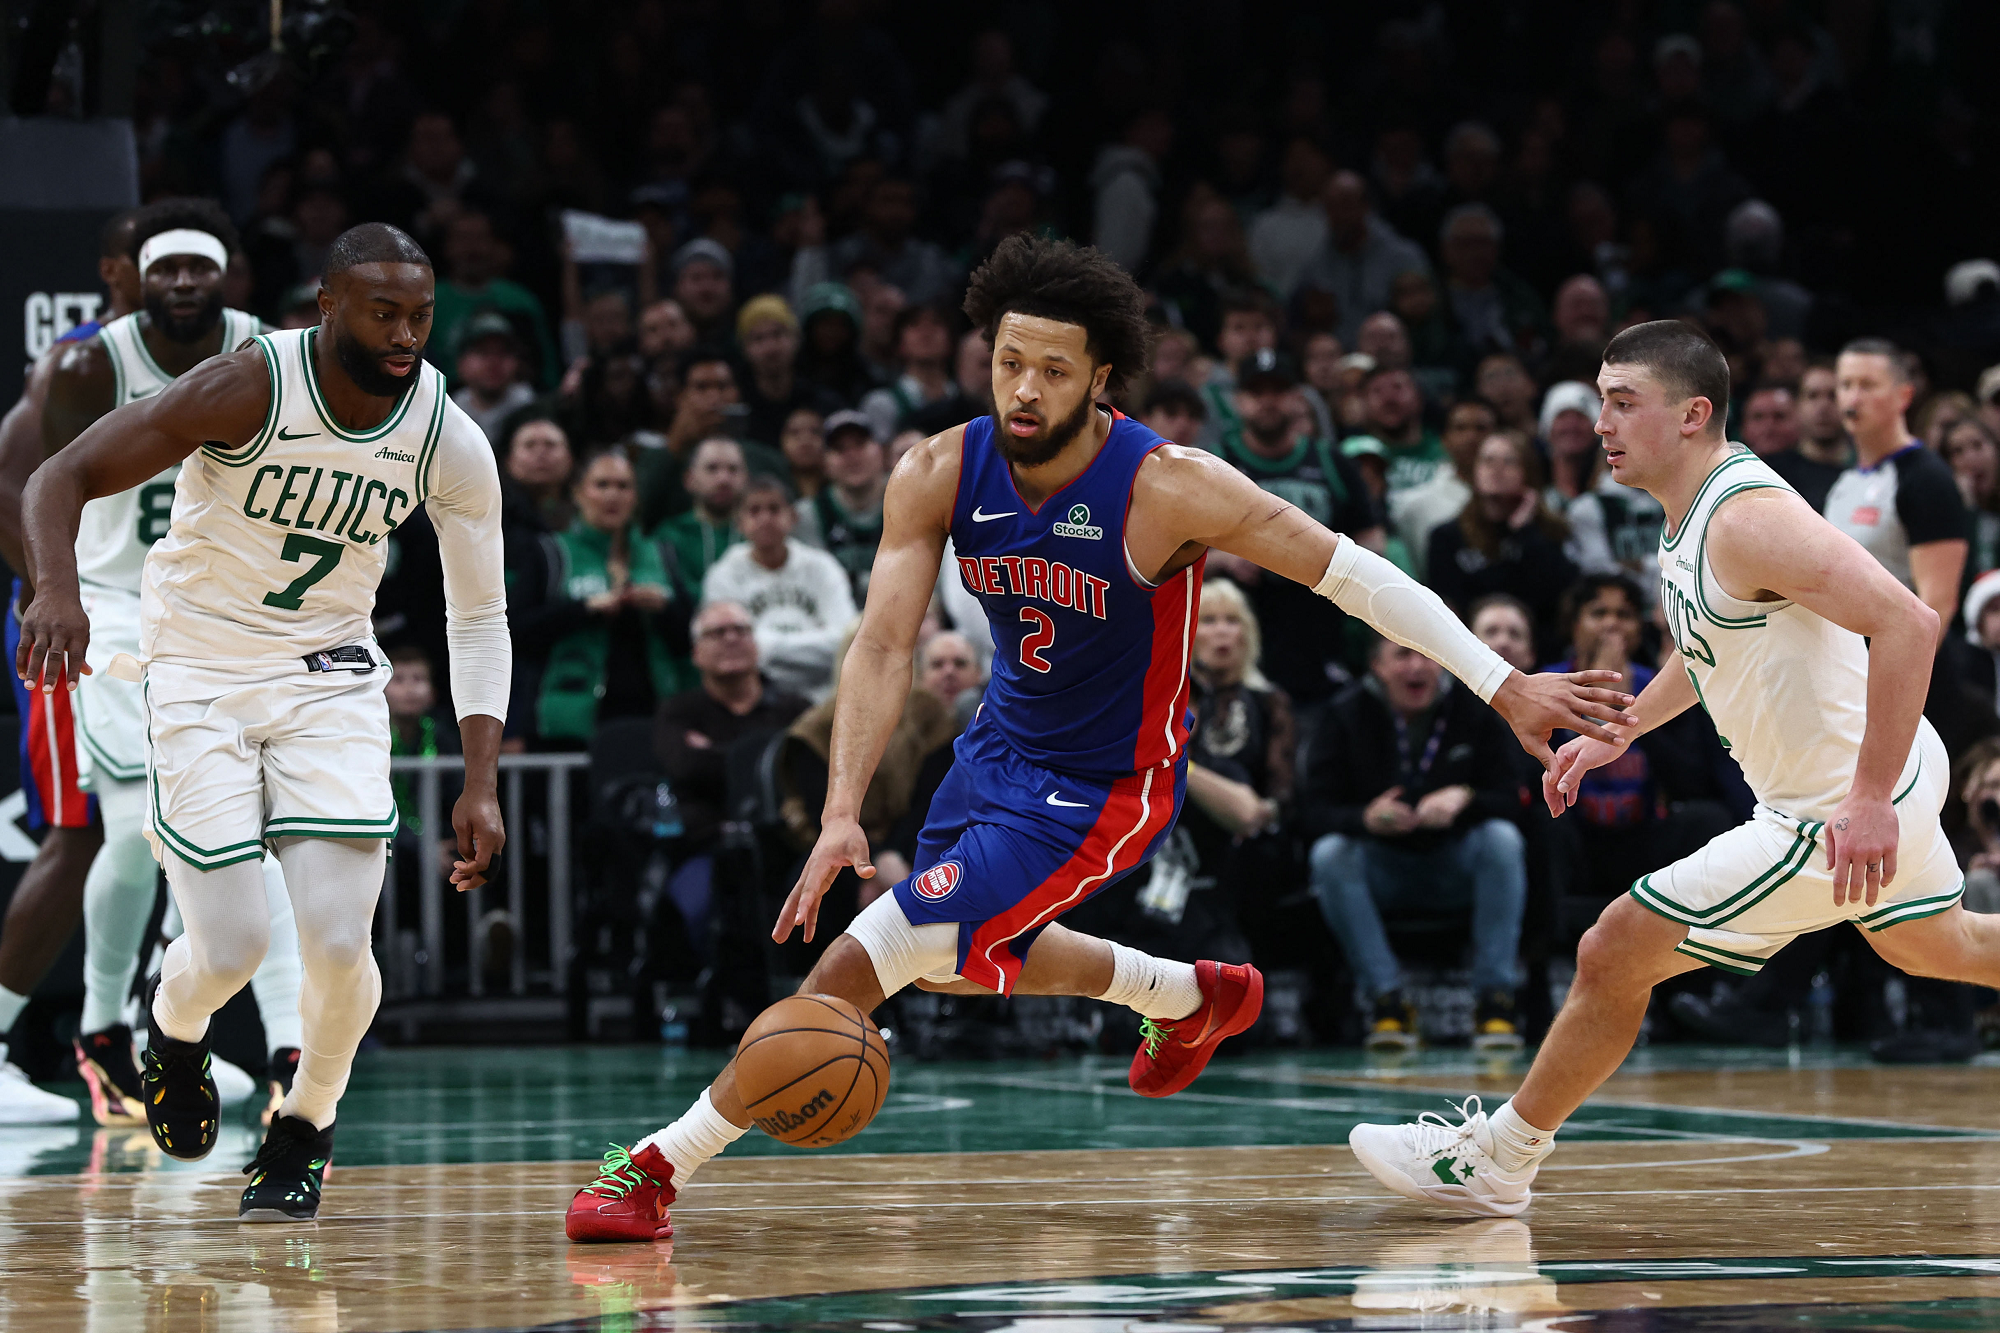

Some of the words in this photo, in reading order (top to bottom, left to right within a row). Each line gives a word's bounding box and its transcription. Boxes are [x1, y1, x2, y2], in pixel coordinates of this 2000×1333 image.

[25, 291, 103, 360] GET
[374, 446, 416, 463] Amica
[243, 464, 409, 546] CELTICS
[1054, 524, 1101, 538] StockX
[261, 532, 347, 612] 7
[956, 556, 1110, 620] DETROIT
[1019, 605, 1056, 674] 2
